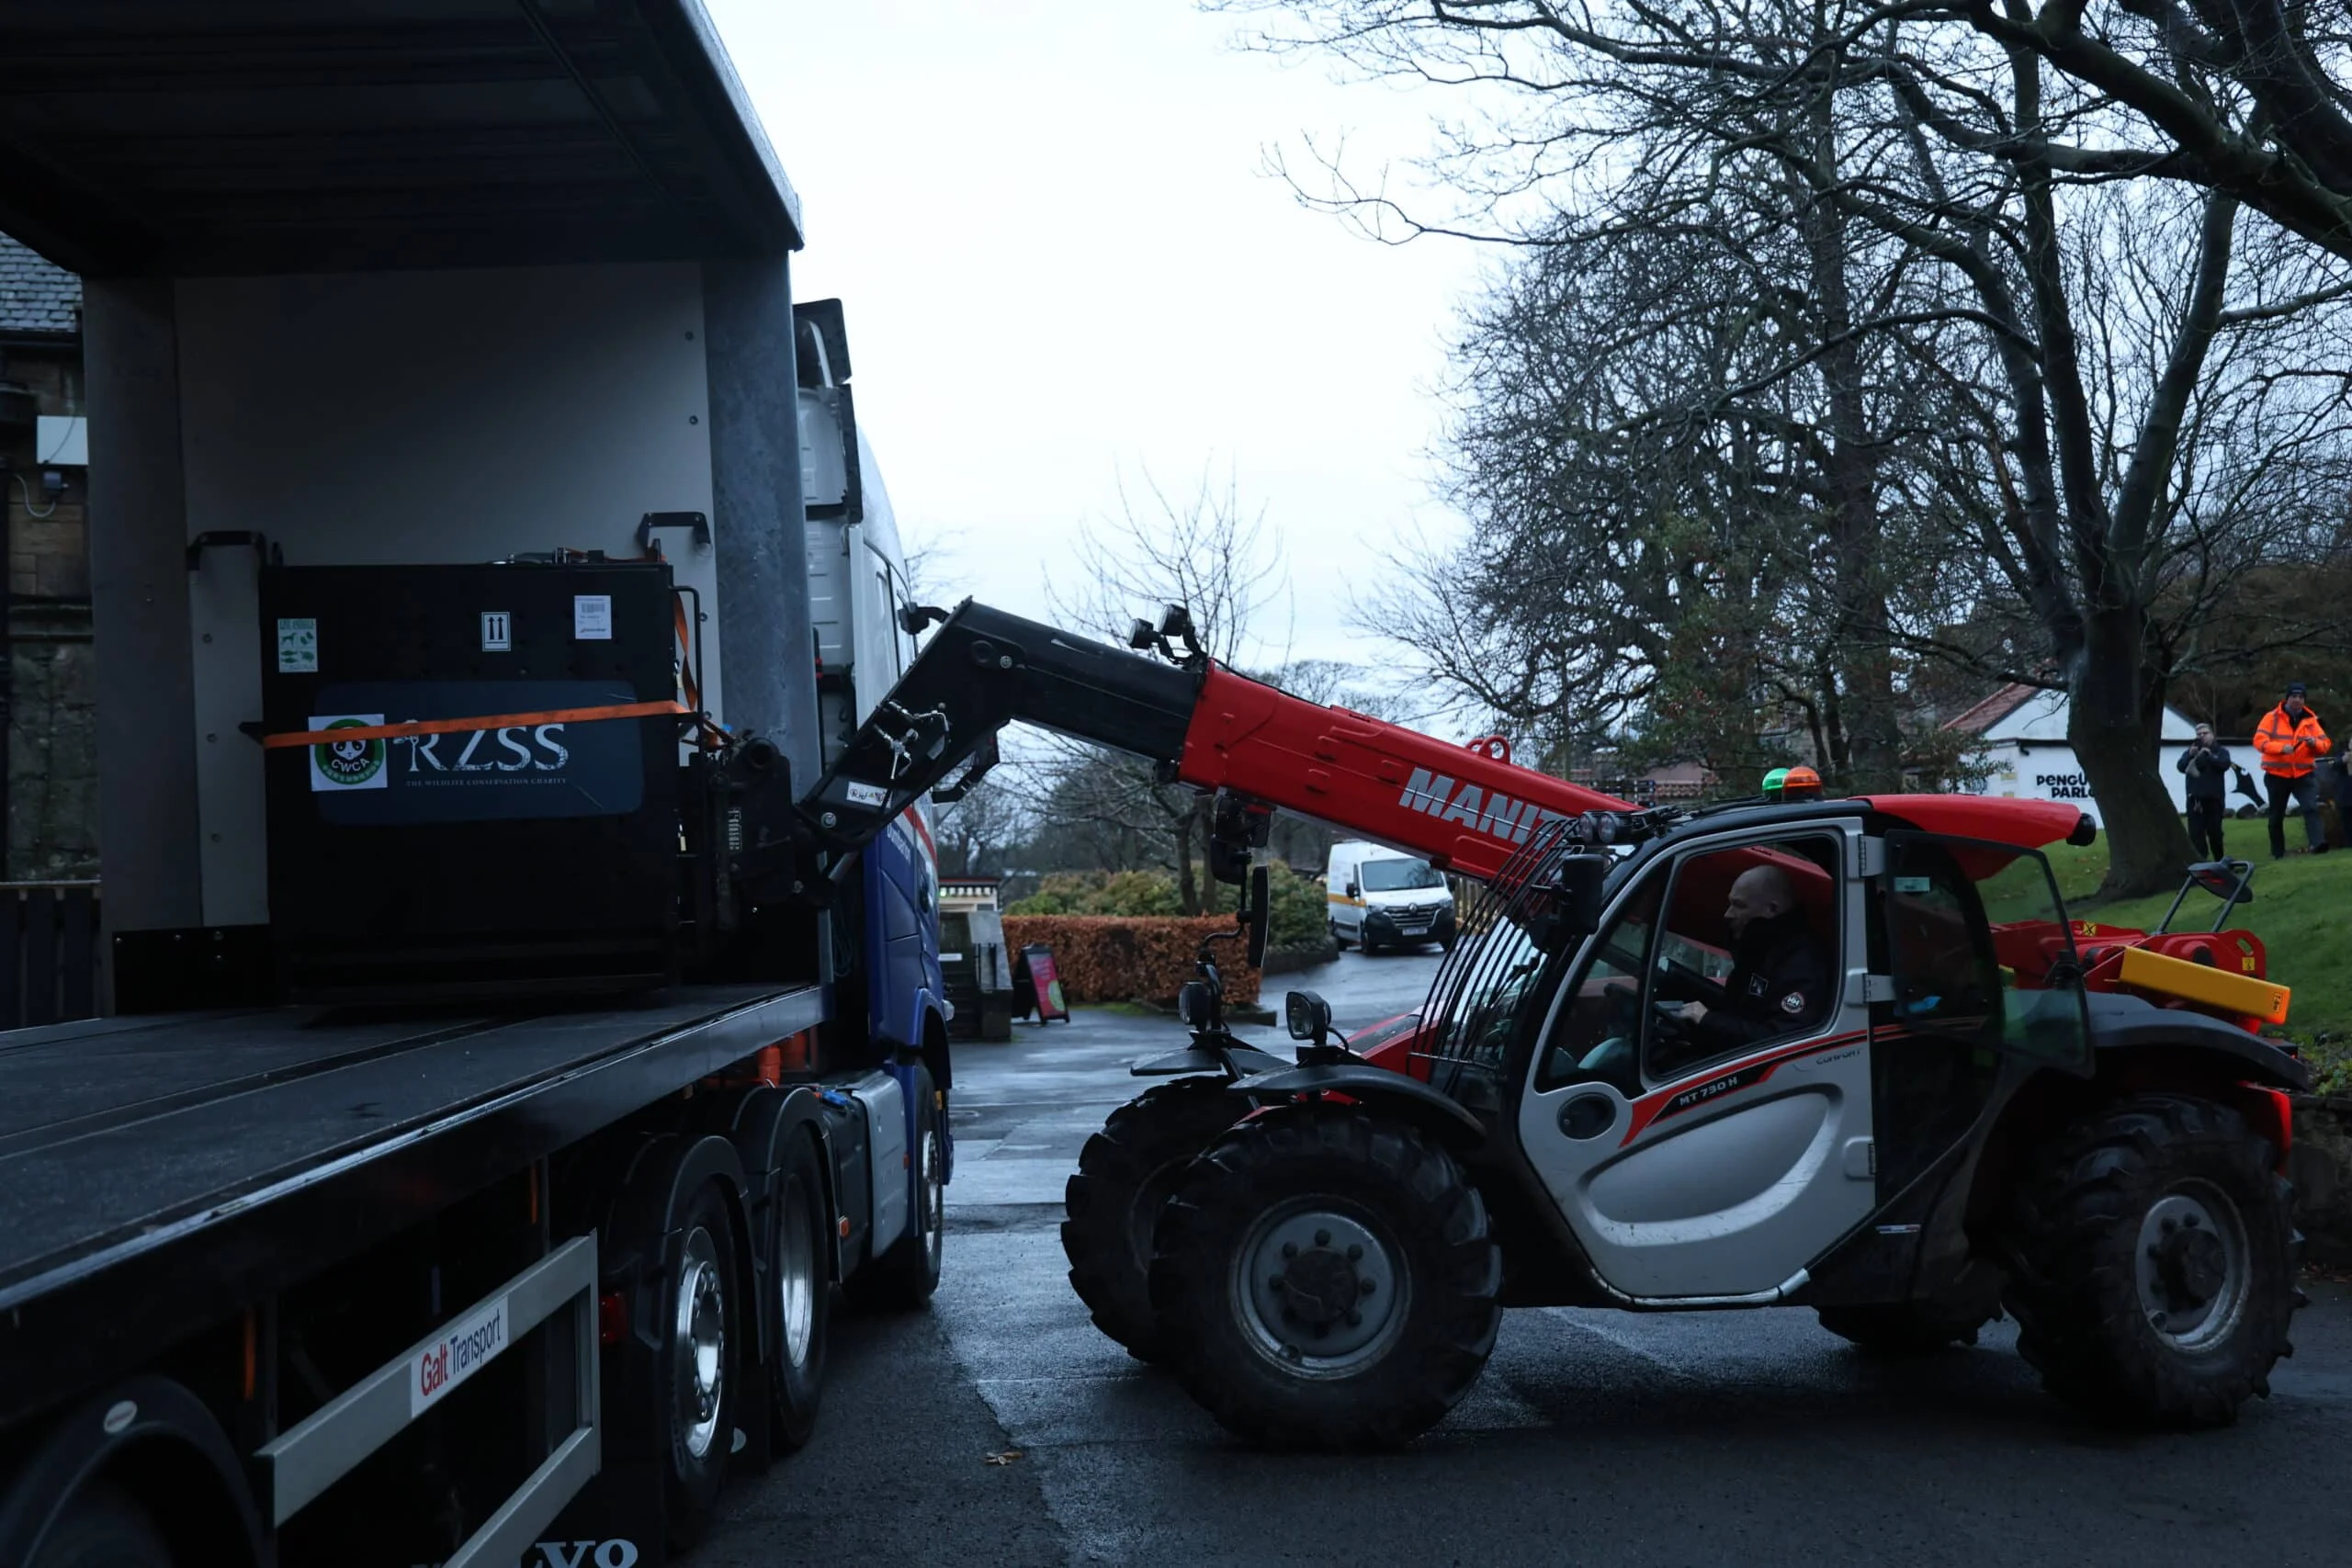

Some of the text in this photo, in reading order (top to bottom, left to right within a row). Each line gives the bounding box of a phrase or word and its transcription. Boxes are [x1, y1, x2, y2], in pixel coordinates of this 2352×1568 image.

[395, 722, 570, 773] RZSS
[331, 758, 371, 773] CWCA
[403, 777, 567, 788] THE WILDLIFE CONSERVATION CHARITY
[1679, 1075, 1738, 1108] MT 730 H
[421, 1307, 501, 1396] Galt Transport
